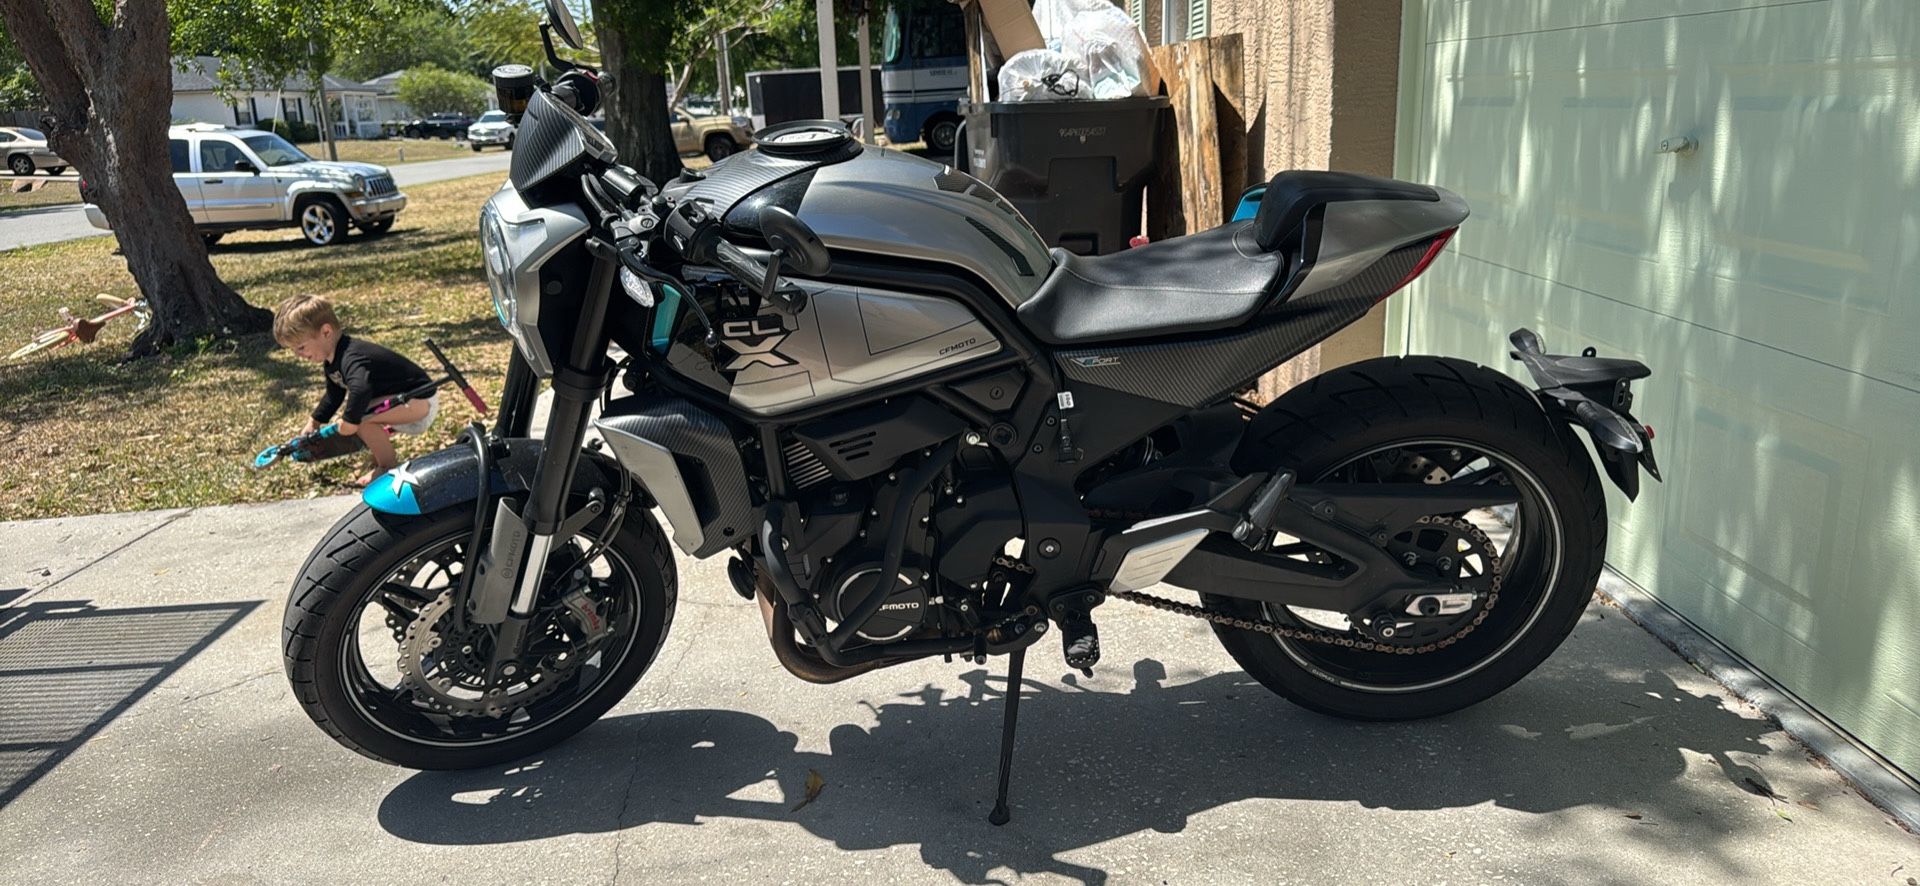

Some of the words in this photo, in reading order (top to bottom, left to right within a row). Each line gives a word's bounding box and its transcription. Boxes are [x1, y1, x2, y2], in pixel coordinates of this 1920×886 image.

[723, 320, 780, 337] CL
[720, 334, 790, 370] X
[939, 337, 976, 355] CFMOTO
[879, 602, 919, 611] FMOTO
